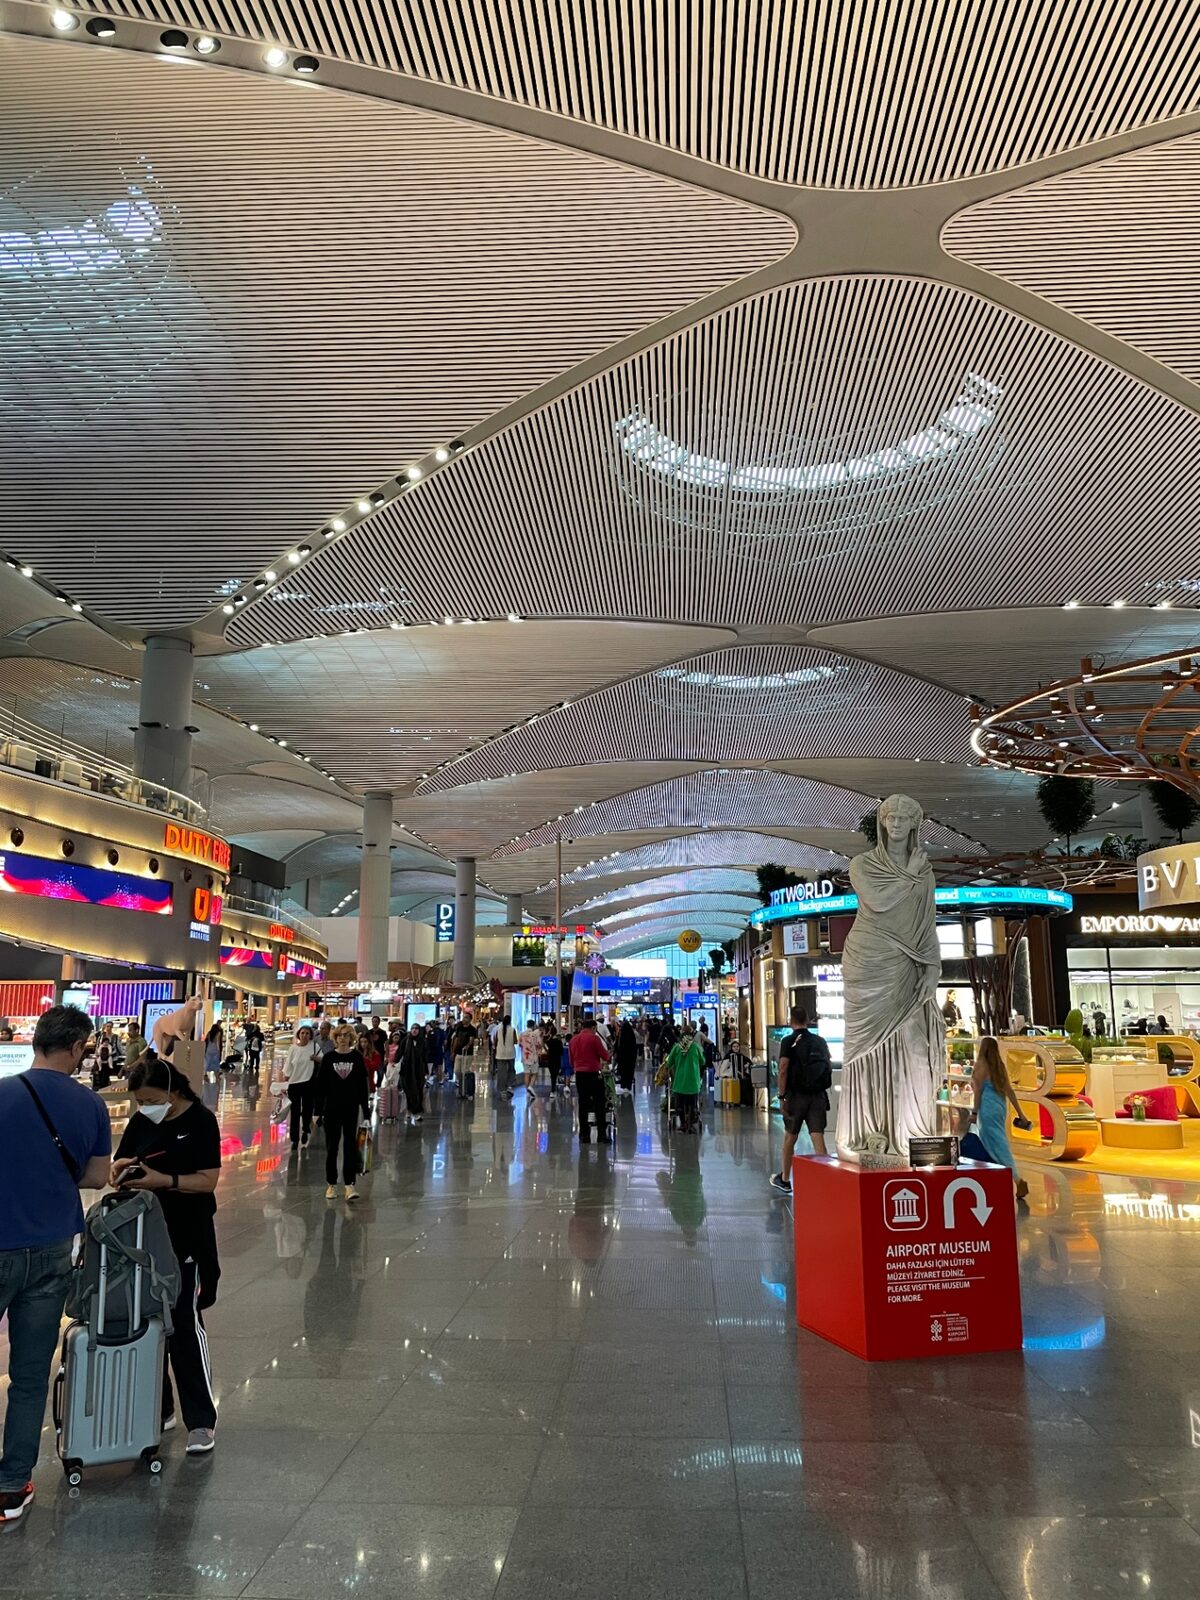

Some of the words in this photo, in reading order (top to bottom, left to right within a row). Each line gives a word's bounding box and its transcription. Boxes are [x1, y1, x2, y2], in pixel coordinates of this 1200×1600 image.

[165, 823, 211, 859] DUTY
[799, 898, 844, 912] Background
[440, 904, 453, 920] D
[1080, 915, 1158, 933] EMPORIO
[347, 981, 377, 990] DUTY
[379, 981, 399, 990] FREE
[421, 987, 440, 995] FREE
[886, 1243, 936, 1257] AIRPORT
[939, 1240, 991, 1255] MUSEUM
[886, 1262, 906, 1270] DAHA
[907, 1260, 934, 1269] FAZLASI
[935, 1258, 949, 1269] İÇİN
[949, 1258, 975, 1267] LÜTFEN
[887, 1270, 913, 1281] MÜZEYİ
[914, 1269, 940, 1279] ZİYARET
[941, 1268, 966, 1277] EDİNİZ.
[887, 1284, 911, 1293] PLEASE
[911, 1283, 927, 1292] VISIT
[928, 1282, 941, 1291] THE
[941, 1281, 970, 1289] MUSEUM
[902, 1294, 923, 1302] MORE.
